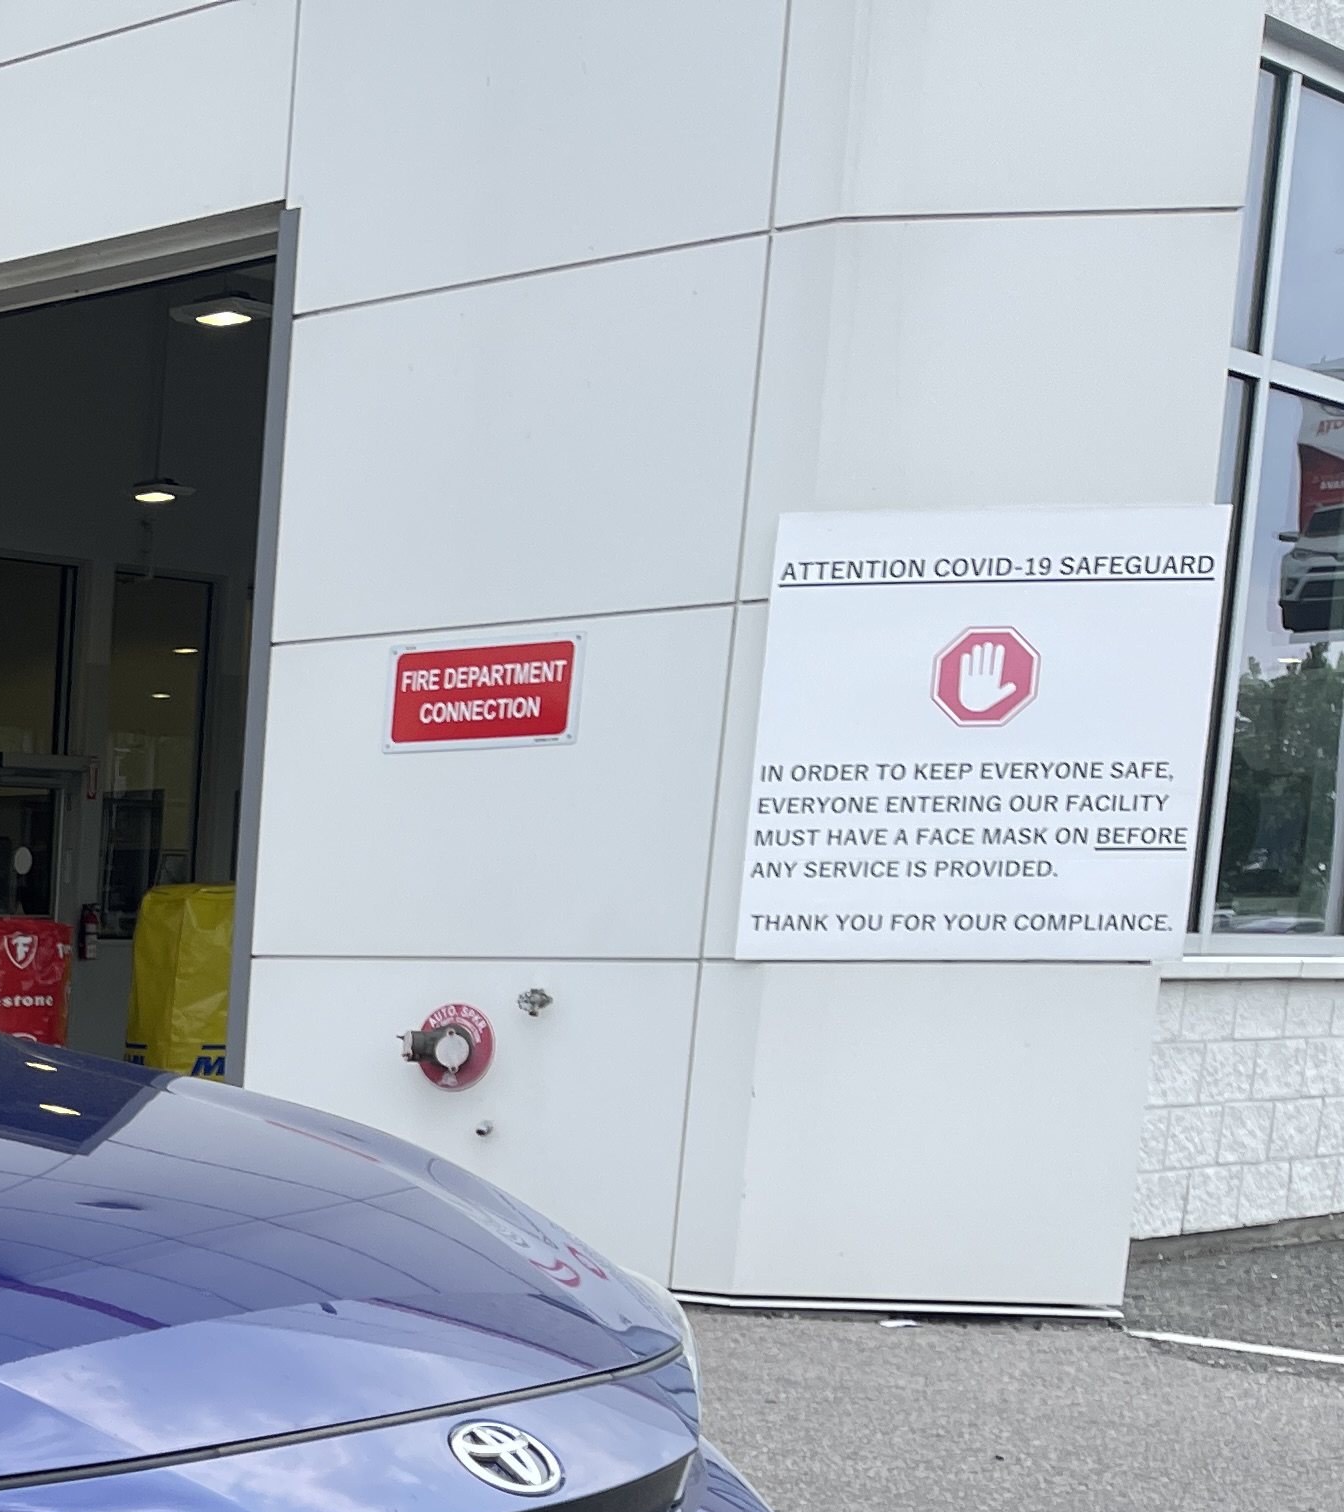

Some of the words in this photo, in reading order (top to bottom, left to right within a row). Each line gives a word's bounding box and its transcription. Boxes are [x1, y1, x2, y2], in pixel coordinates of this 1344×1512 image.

[781, 560, 926, 581] ATTENTION
[934, 557, 1052, 578] COVID-19
[1059, 555, 1216, 576] SAFEGUARD
[401, 669, 441, 692] FIRE
[443, 660, 567, 690] DEPARTMENT
[419, 696, 541, 724] CONNECTION
[760, 764, 784, 782] IN
[791, 764, 869, 782] ORDER
[876, 763, 907, 781] TO
[913, 762, 973, 781] KEEP
[980, 761, 1104, 780] EVERYONE
[1110, 761, 1174, 781] SAFE,
[758, 796, 879, 814] EVERYONE
[886, 795, 1002, 814] ENTERING
[1009, 794, 1059, 812] OUR
[1065, 794, 1170, 812] FACILITY
[754, 829, 821, 847] MUST
[826, 828, 888, 846] HAVE
[894, 828, 909, 846] A
[916, 827, 976, 846] FACE
[982, 827, 1048, 845] MASK
[1055, 827, 1088, 845] ON
[1096, 826, 1188, 845] BEFORE
[750, 861, 798, 879] ANY
[803, 861, 900, 878] SERVICE
[907, 860, 928, 878] IS
[934, 860, 1058, 878] PROVIDED.
[751, 914, 829, 931] THANK
[835, 913, 883, 931] YOU
[890, 913, 936, 931] FOR
[944, 913, 1007, 931] YOUR
[1014, 913, 1174, 932] COMPLIANCE.
